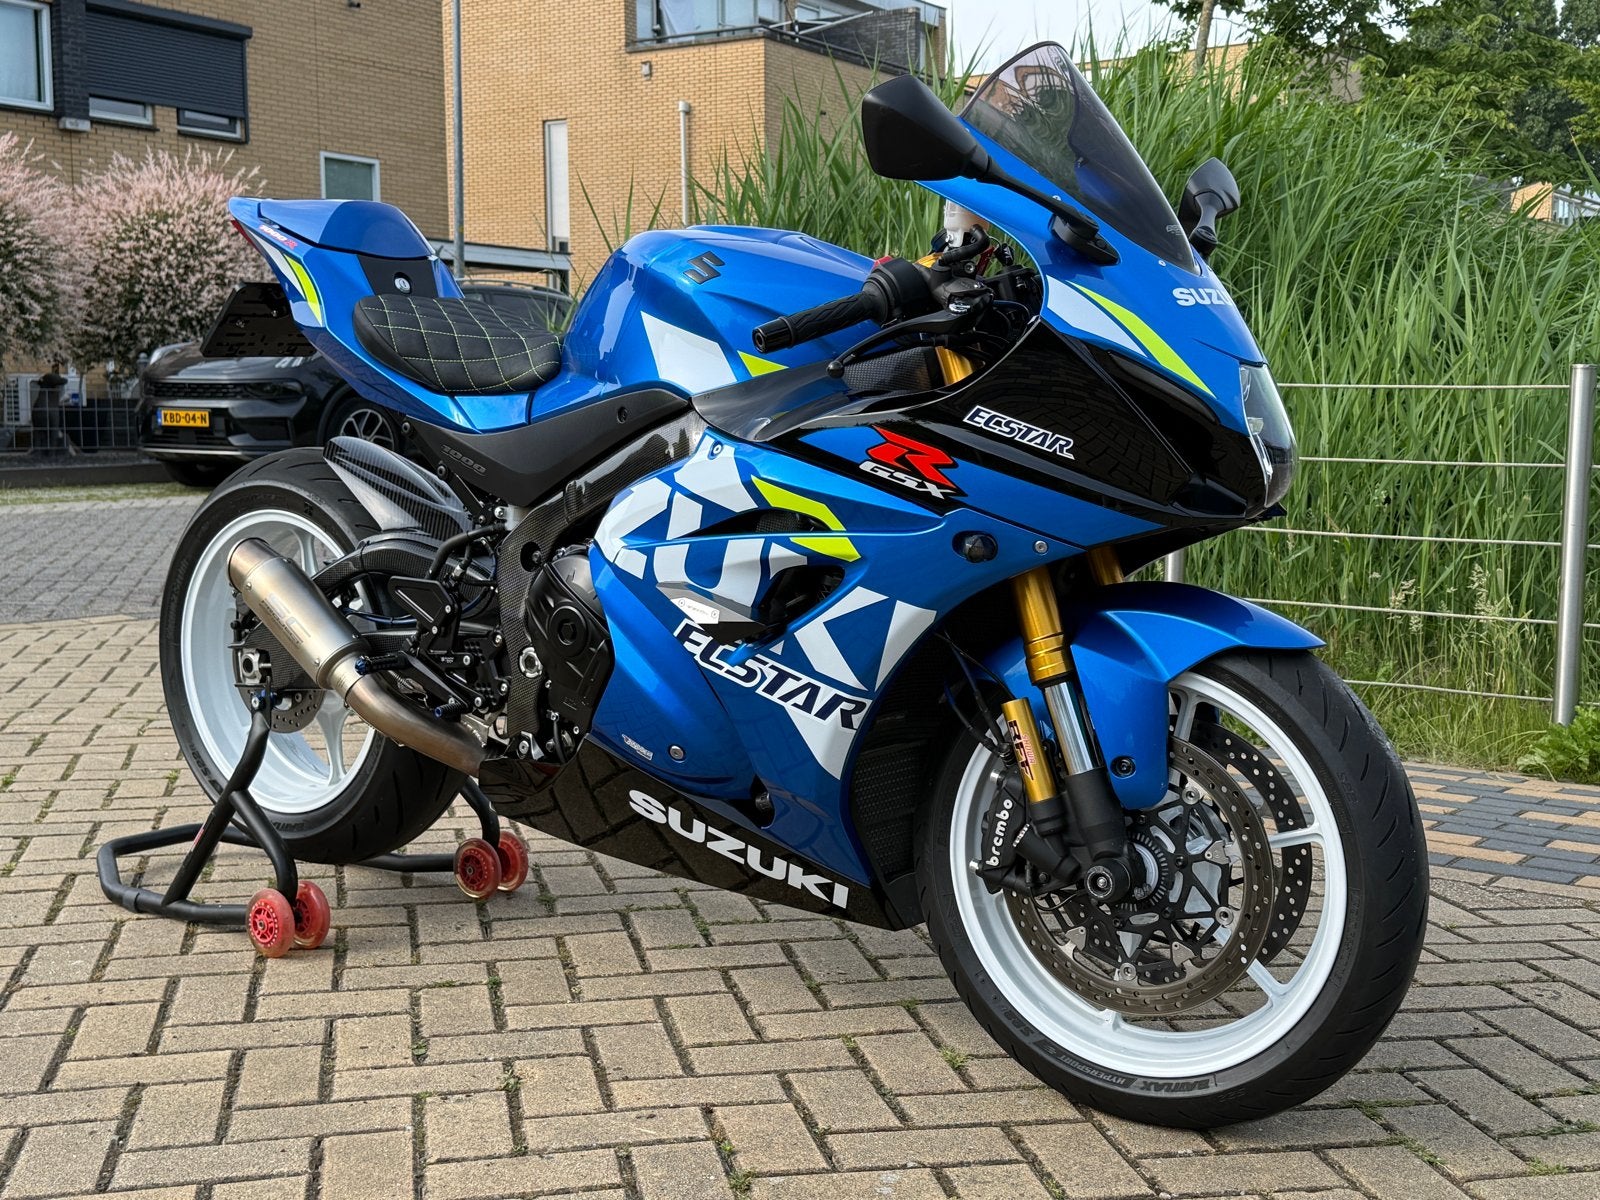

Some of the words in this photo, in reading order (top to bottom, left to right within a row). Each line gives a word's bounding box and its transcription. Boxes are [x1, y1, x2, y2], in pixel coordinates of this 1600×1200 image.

[163, 412, 207, 425] KBD-04-N
[963, 405, 1075, 460] ECSTAR
[859, 460, 957, 500] GSX
[867, 425, 957, 489] R
[673, 618, 872, 732] ECSTAR
[629, 789, 849, 909] SUZUKI
[986, 799, 1013, 867] brembo
[1058, 1054, 1126, 1085] HYPERSPORT
